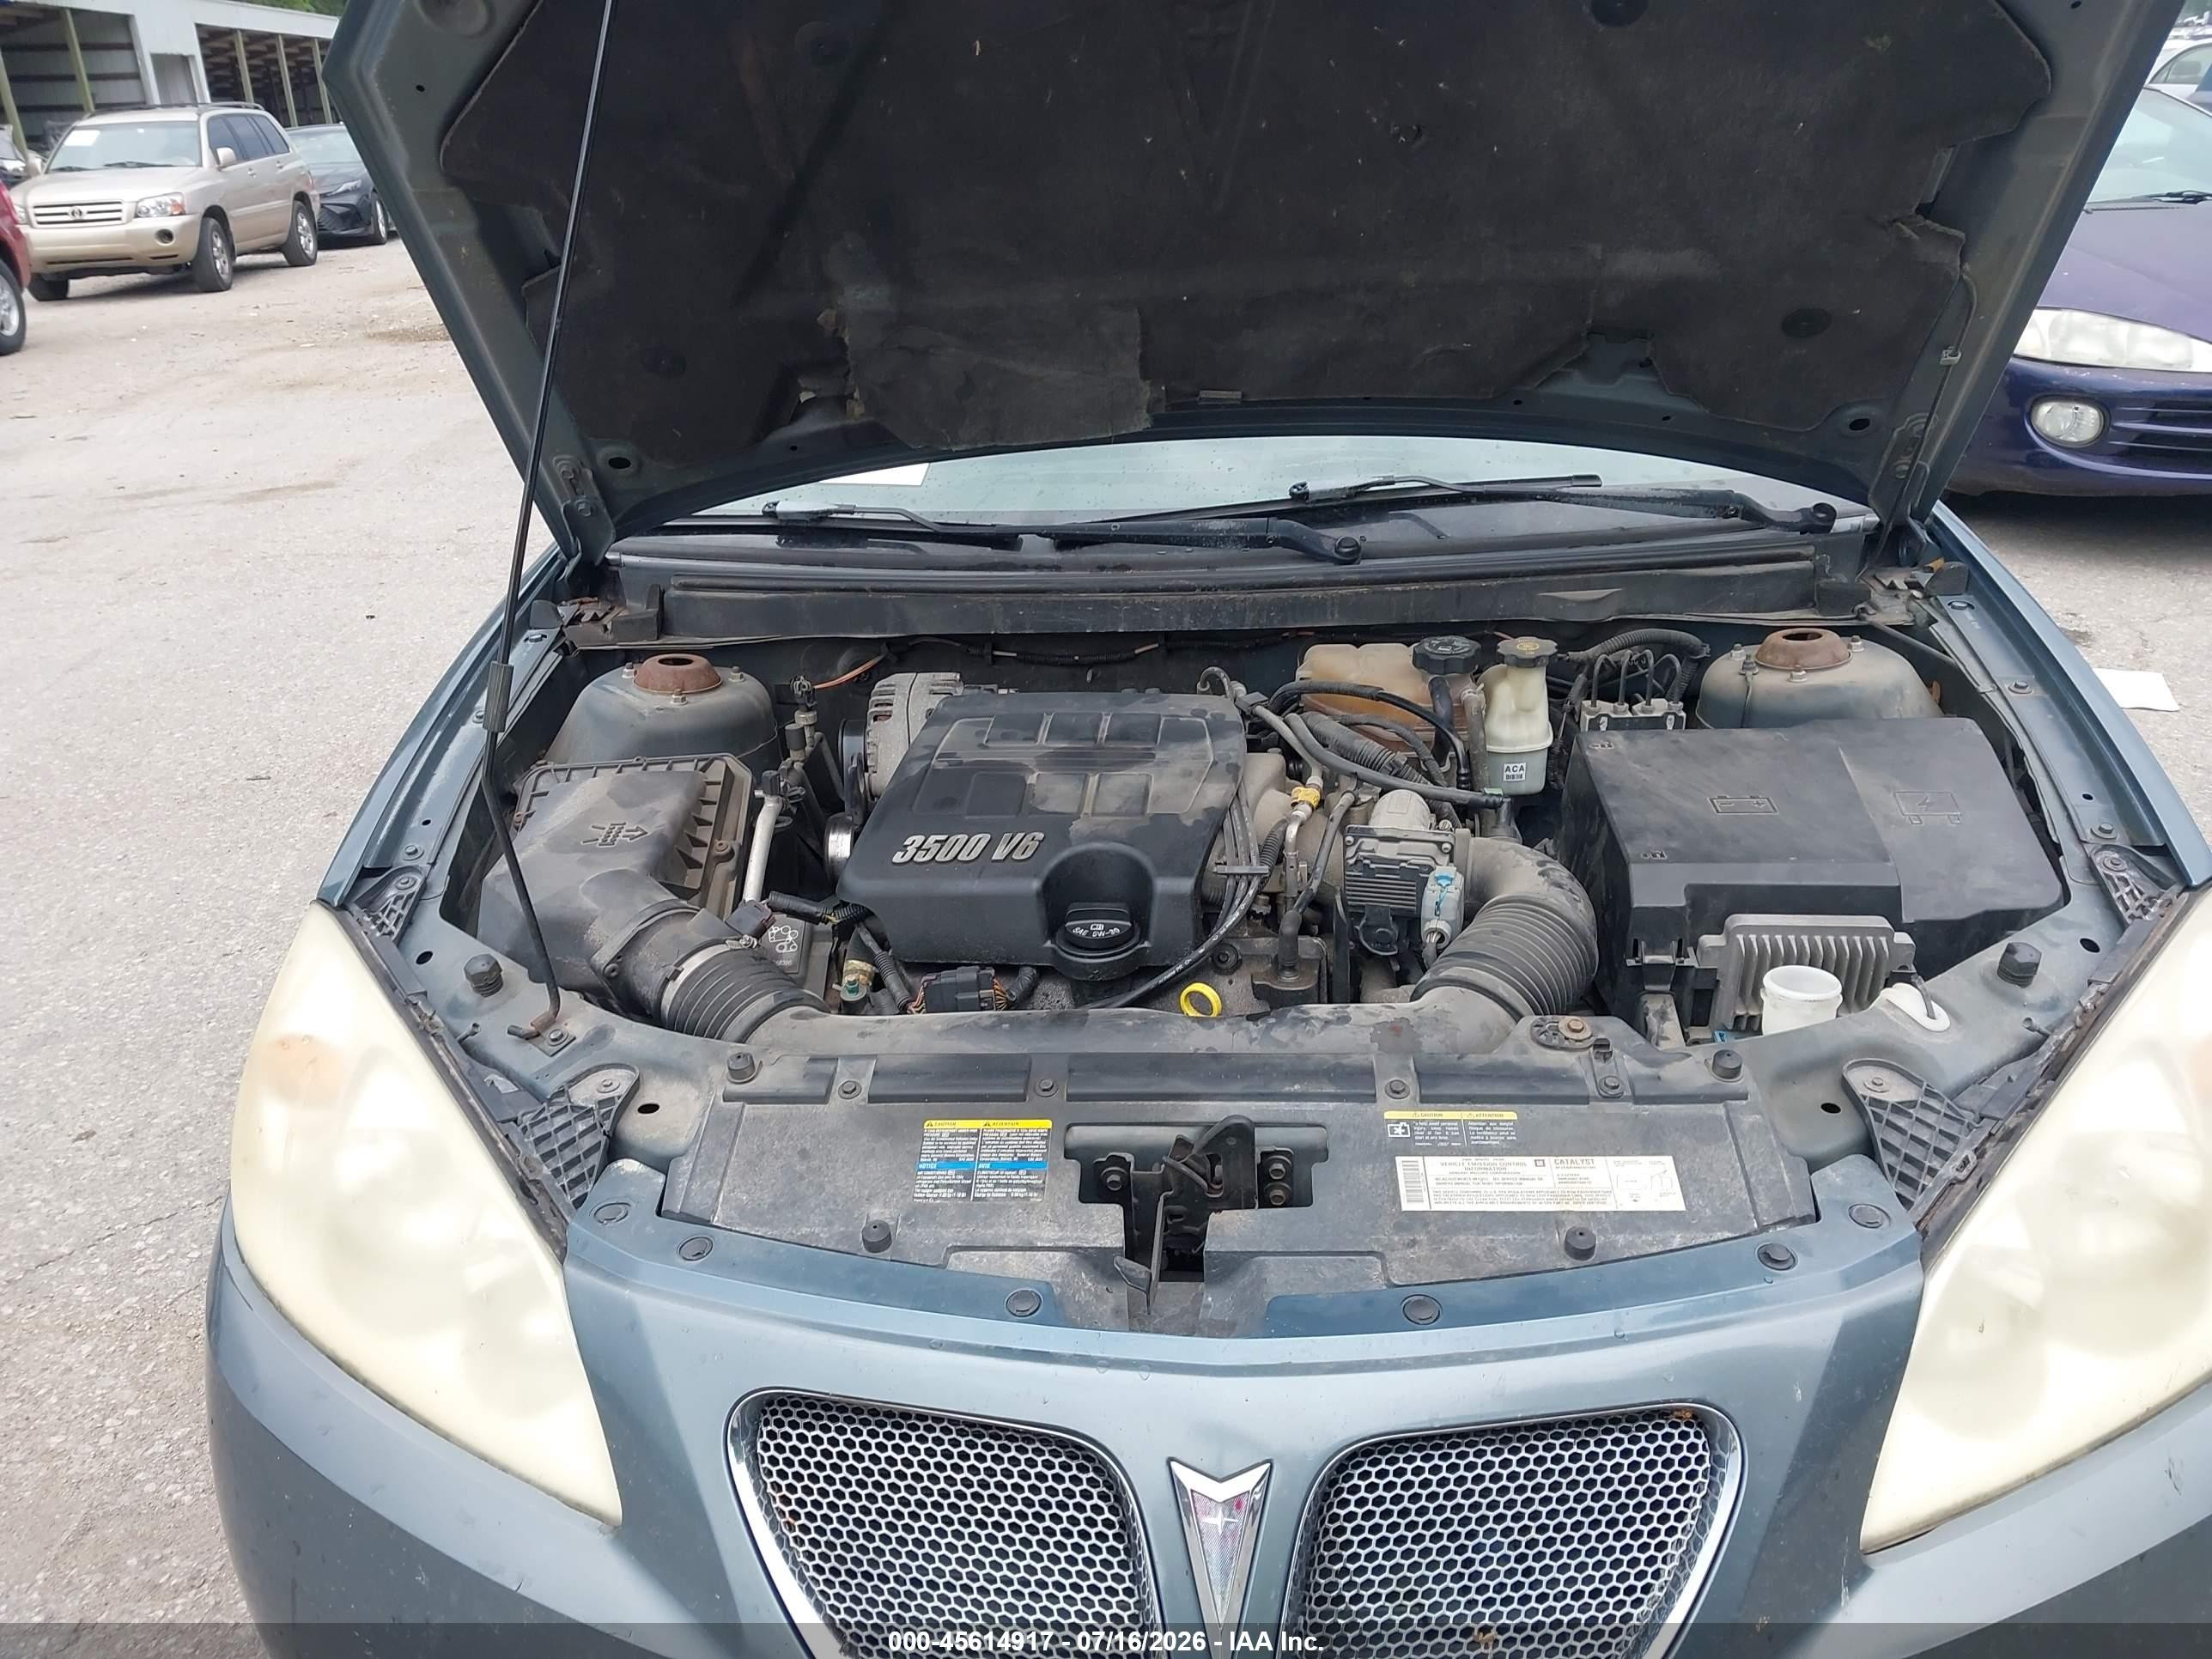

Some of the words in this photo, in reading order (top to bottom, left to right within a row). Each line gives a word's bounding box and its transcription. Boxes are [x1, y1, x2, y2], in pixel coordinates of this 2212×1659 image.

[891, 833, 992, 864] 3500
[991, 831, 1046, 861] V6
[1073, 927, 1090, 936] SAE
